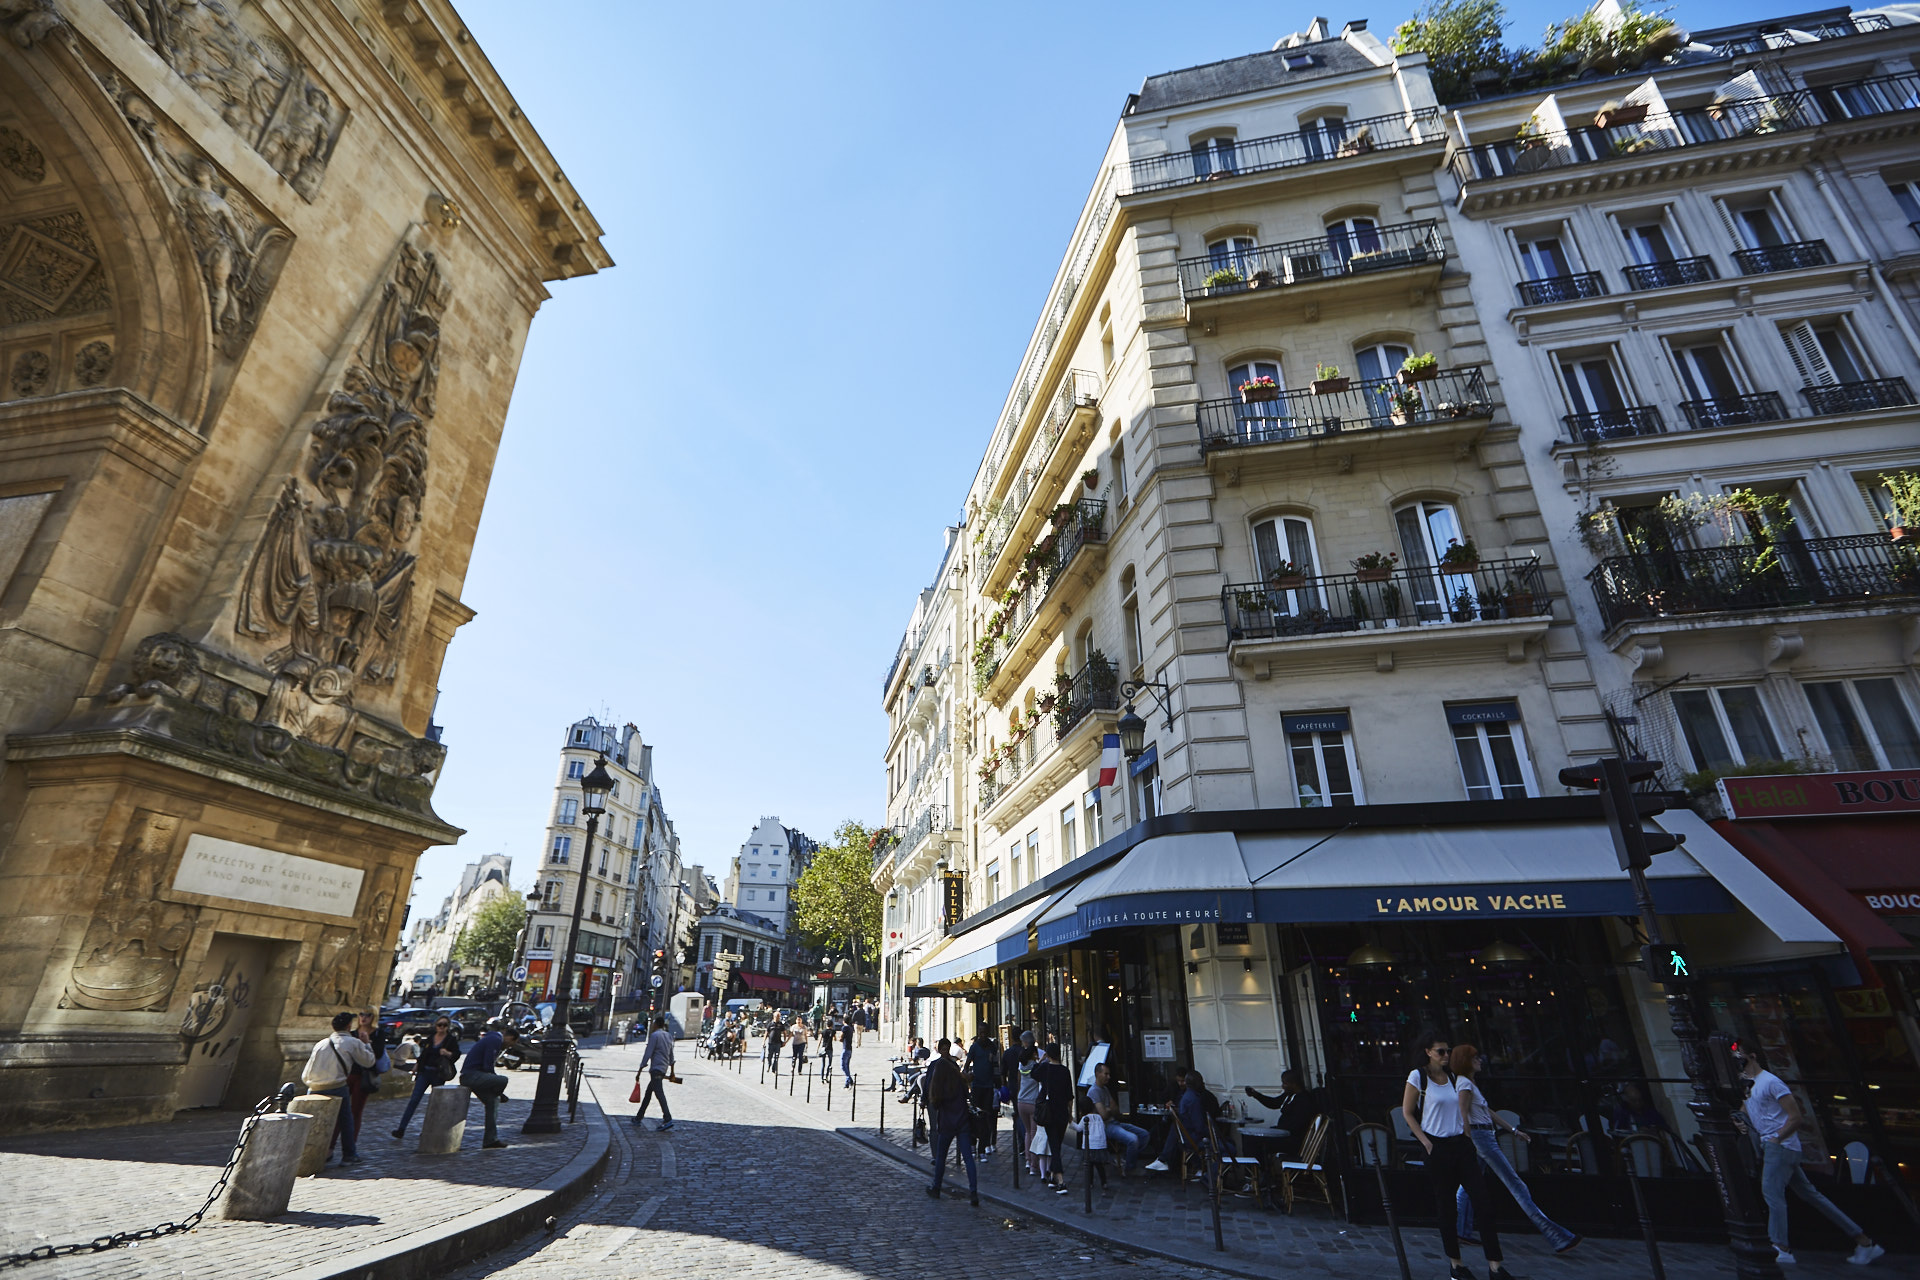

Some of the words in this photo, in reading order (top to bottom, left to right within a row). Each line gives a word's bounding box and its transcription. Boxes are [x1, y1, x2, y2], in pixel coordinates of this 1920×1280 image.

[1461, 711, 1506, 721] COCKTAILS
[1296, 721, 1337, 731] CAFÉTERIE
[1732, 784, 1808, 809] Halal
[261, 865, 274, 874] ET
[206, 870, 233, 882] ANNO
[1376, 896, 1480, 913] L'AMOUR
[1487, 894, 1567, 910] VACHE
[1122, 911, 1129, 921] À
[1134, 911, 1168, 920] TOUTE
[1175, 909, 1220, 919] HEURE
